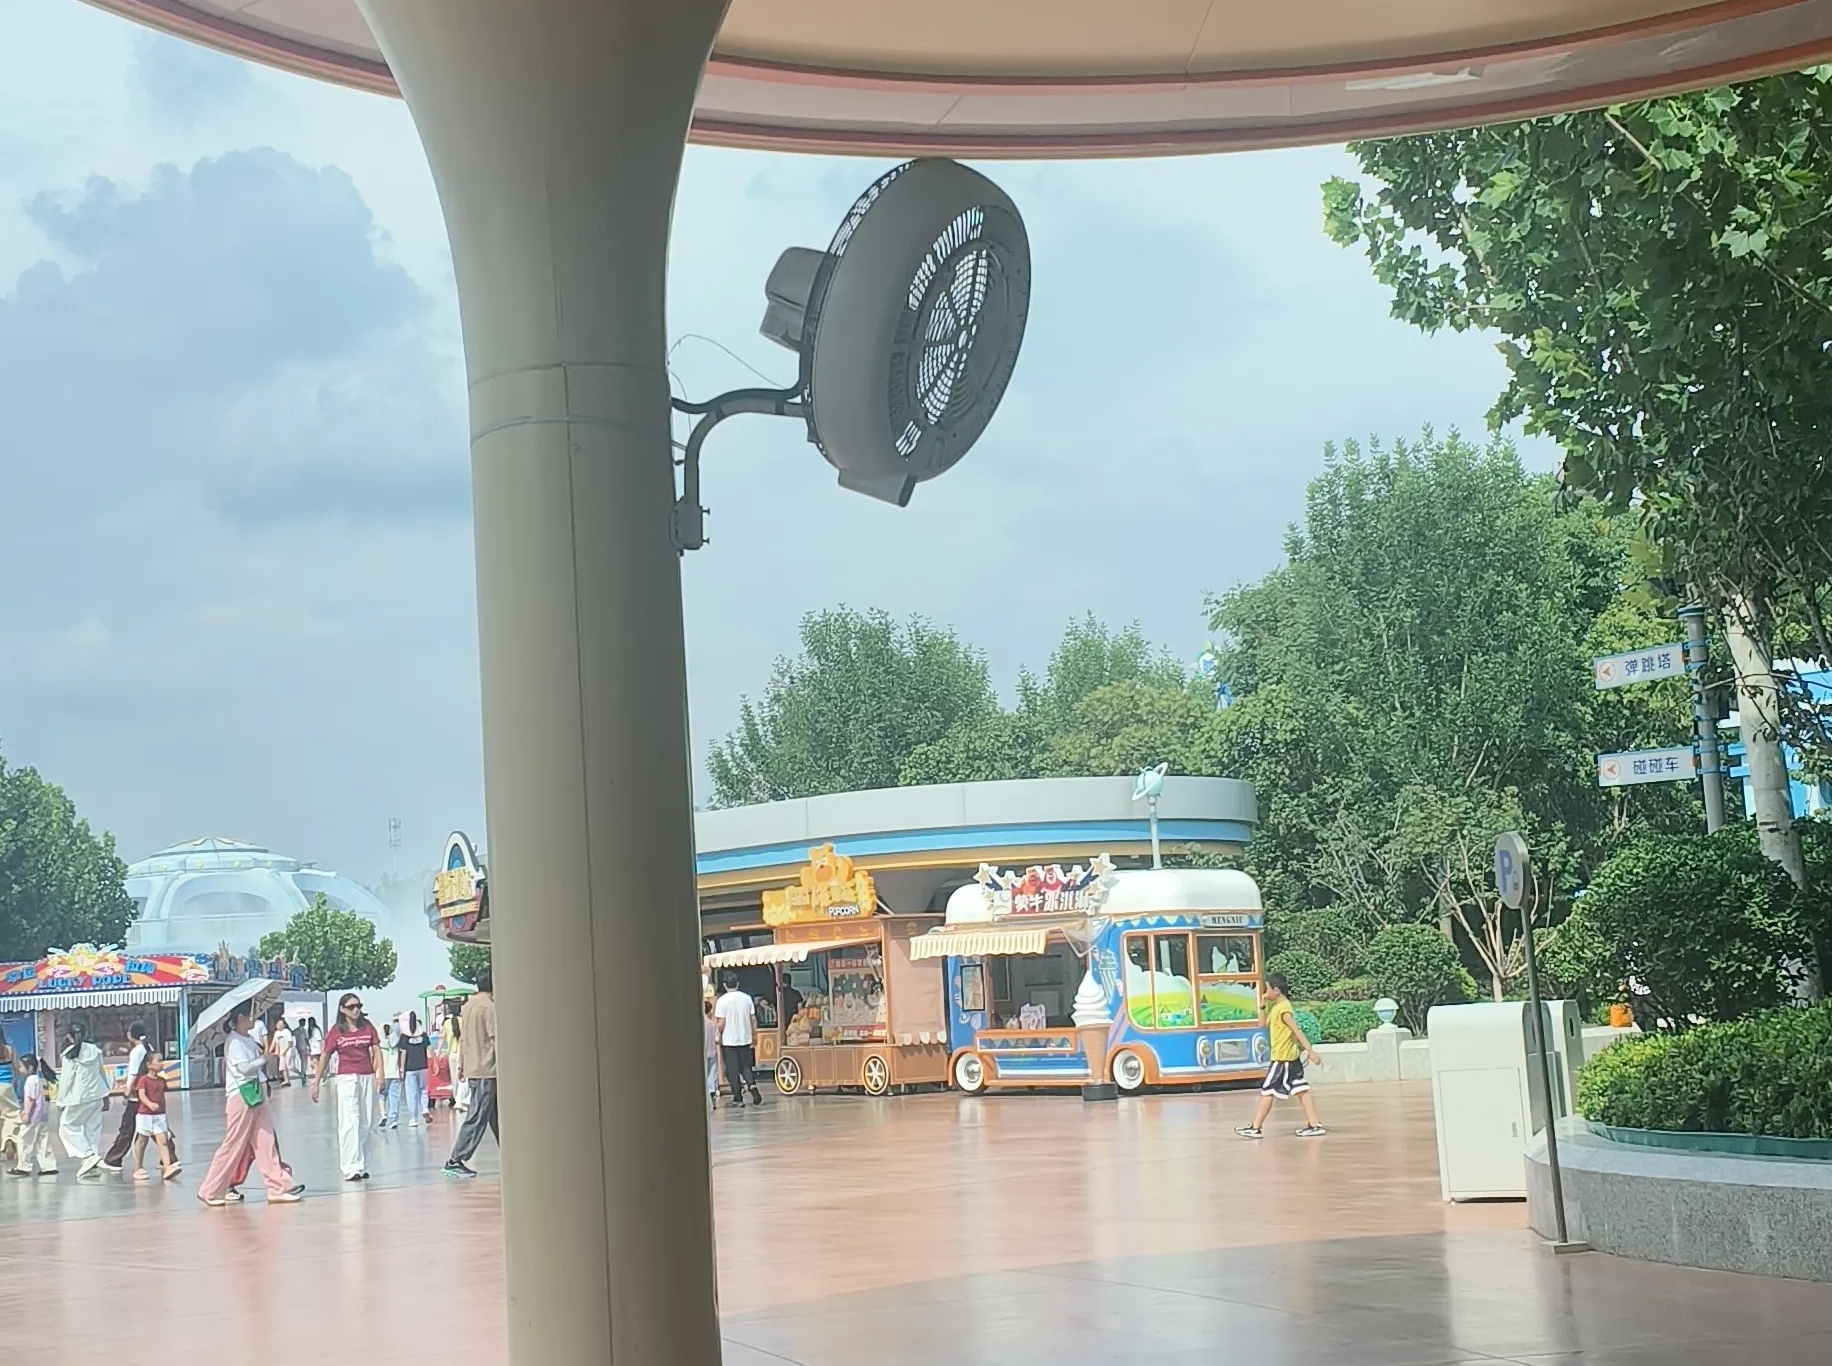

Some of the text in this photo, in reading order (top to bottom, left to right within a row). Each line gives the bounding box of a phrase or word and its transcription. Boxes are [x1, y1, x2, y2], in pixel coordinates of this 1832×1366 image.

[1624, 653, 1671, 676] 弹跳塔
[1633, 756, 1680, 775] 碰碰车
[1500, 849, 1513, 892] P
[828, 905, 859, 915] POPCORN
